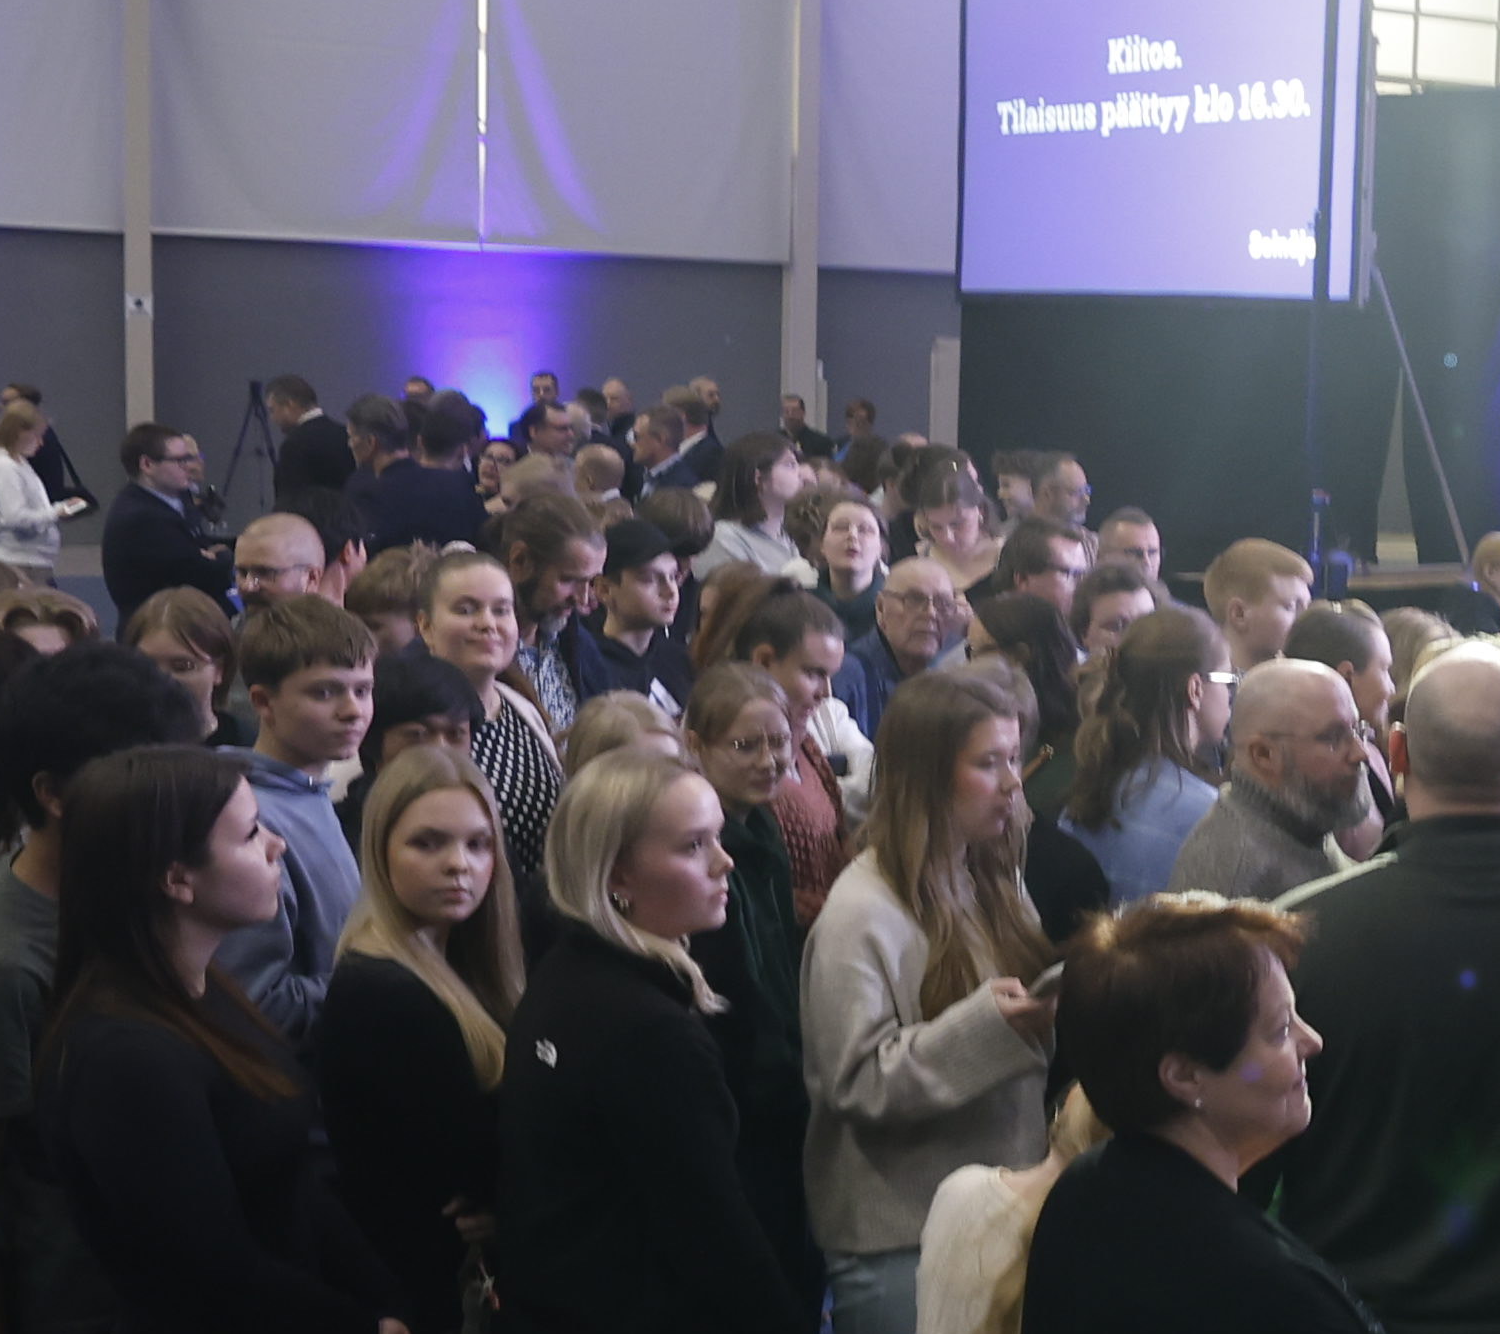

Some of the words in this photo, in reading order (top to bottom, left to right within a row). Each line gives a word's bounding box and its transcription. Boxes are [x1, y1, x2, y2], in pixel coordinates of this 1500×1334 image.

[1106, 34, 1183, 76] Kiitos.
[997, 96, 1097, 136] Tilaisuus
[1100, 91, 1191, 138] päättyy
[1193, 82, 1234, 125] klo
[1248, 228, 1316, 268] Seinäjo
